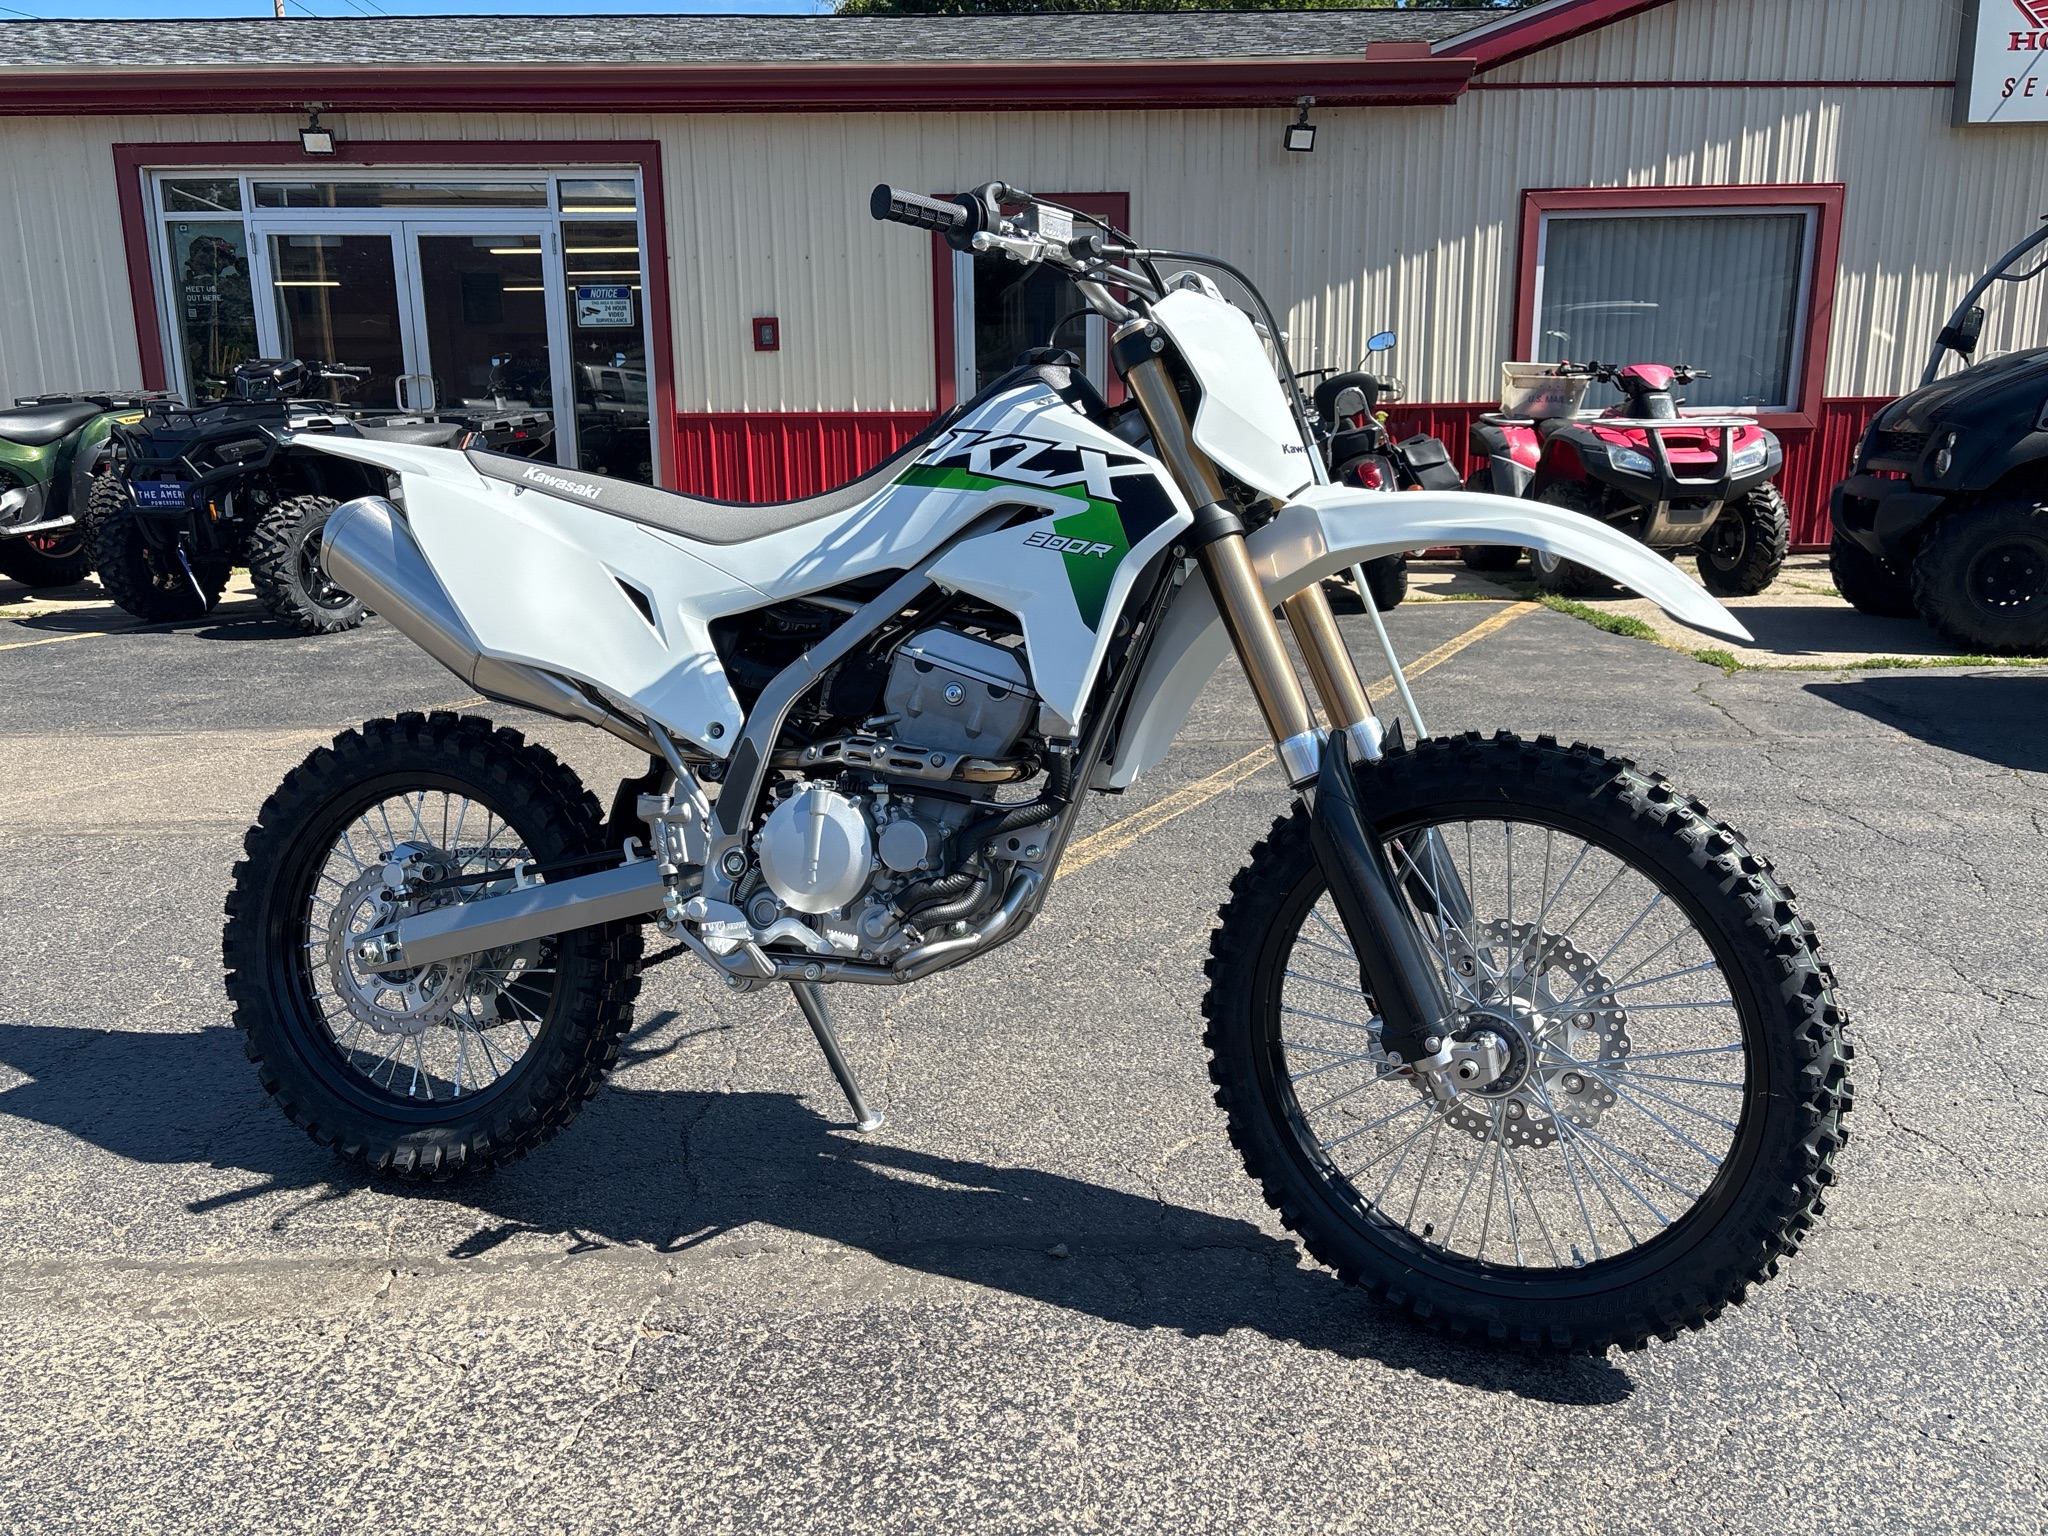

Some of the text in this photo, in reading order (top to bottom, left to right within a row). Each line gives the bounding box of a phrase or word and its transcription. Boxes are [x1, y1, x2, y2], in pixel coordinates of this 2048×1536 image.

[2001, 77, 2048, 98] SE
[590, 288, 618, 298] NOTICE
[914, 429, 1148, 502] KLX
[138, 490, 157, 499] THE
[522, 466, 603, 500] Kawasaki
[1023, 531, 1115, 559] 300R
[1498, 1282, 1653, 1321] DUNLOP
